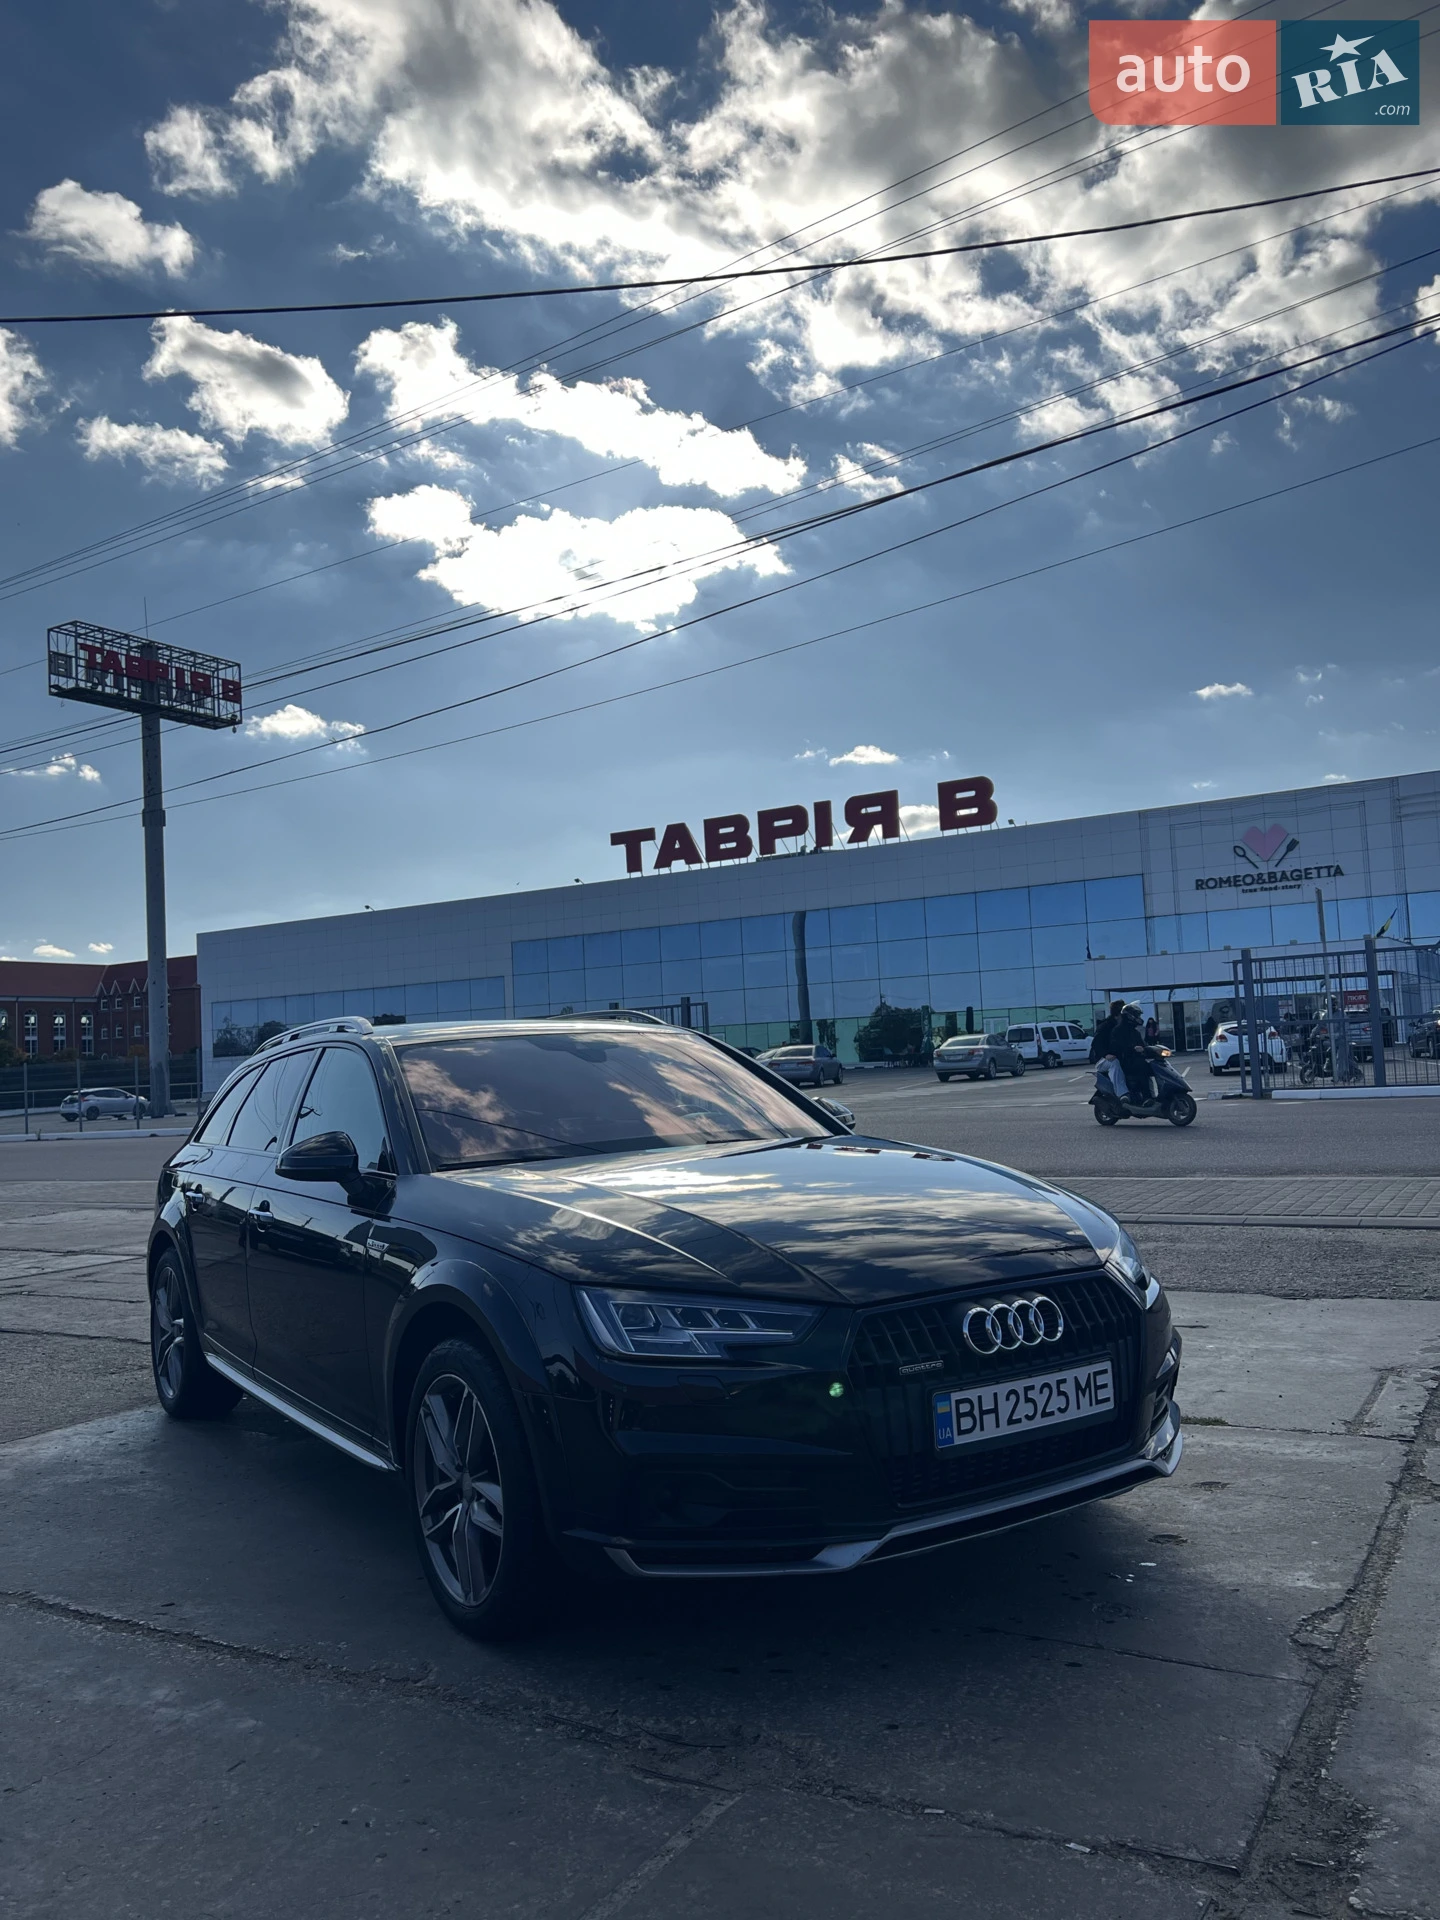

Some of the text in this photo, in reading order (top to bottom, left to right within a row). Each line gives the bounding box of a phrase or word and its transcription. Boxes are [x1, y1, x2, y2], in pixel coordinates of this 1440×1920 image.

[79, 643, 212, 697] ТАВРІЯ
[610, 775, 999, 874] ТАВРІЯ В
[1195, 864, 1344, 891] ROMEO&BAGETTA
[938, 1427, 952, 1440] UA
